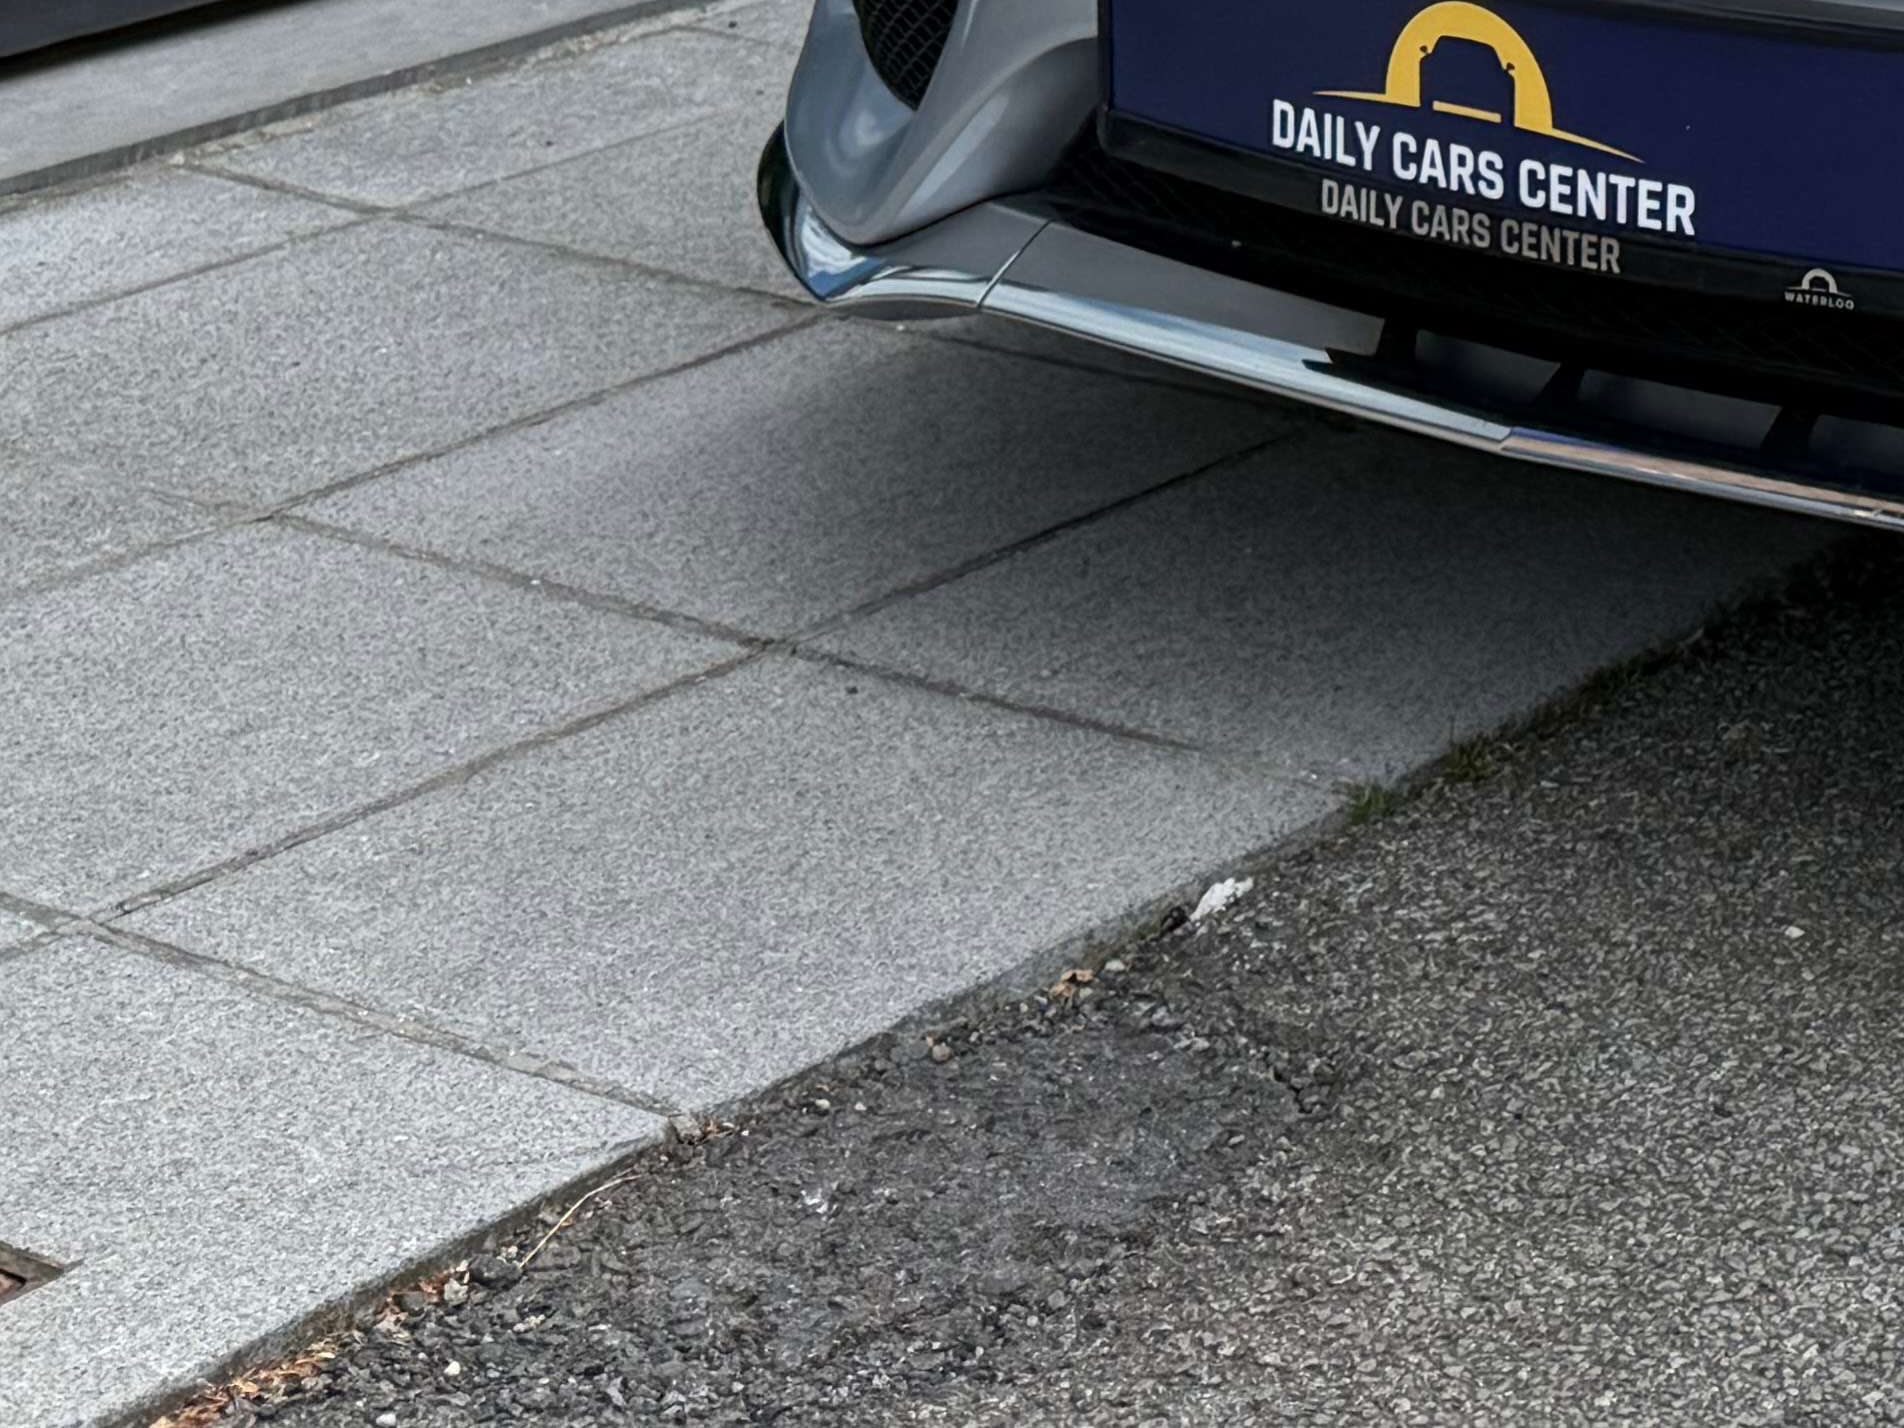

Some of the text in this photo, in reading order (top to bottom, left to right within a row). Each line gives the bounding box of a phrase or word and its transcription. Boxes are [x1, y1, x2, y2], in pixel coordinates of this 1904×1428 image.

[1271, 97, 1696, 236] DAILY CARS CENTER
[1320, 178, 1621, 275] DAILY CARS CENTER
[1784, 291, 1855, 310] WATERLOO
